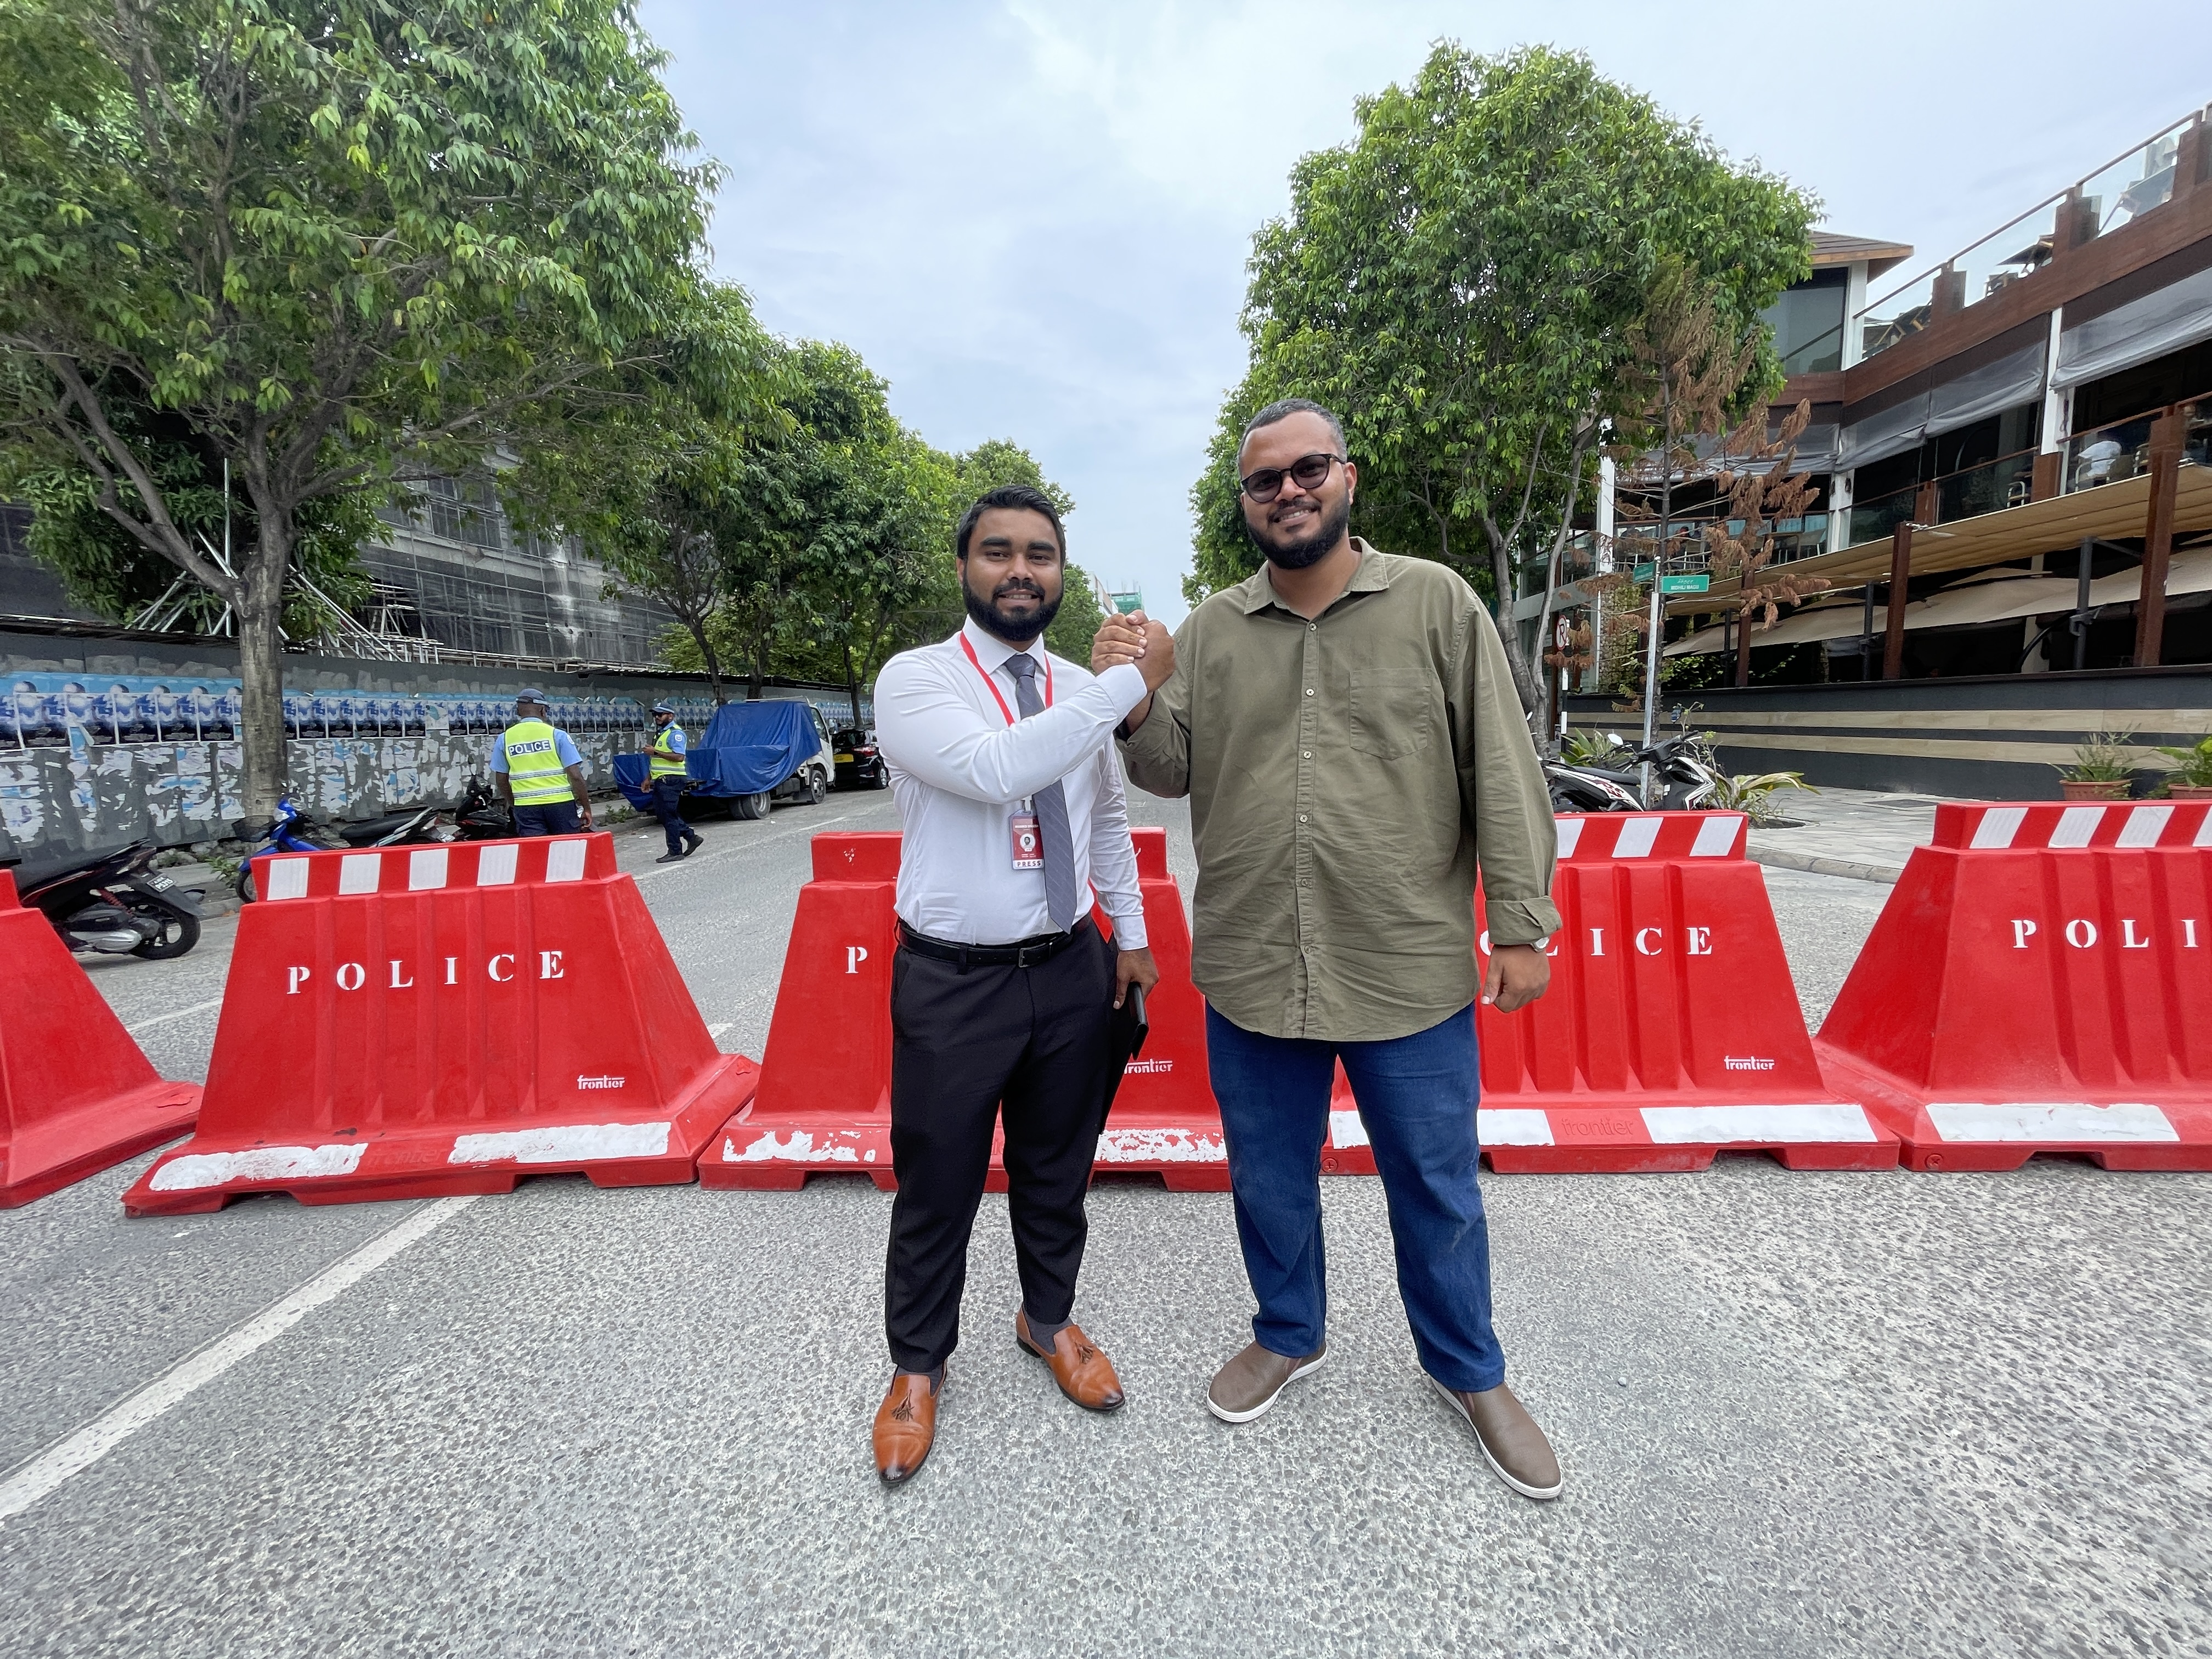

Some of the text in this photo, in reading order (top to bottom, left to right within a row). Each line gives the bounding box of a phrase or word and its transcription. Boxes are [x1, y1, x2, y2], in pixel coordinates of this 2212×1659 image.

[509, 741, 550, 755] POLICE
[2010, 919, 2199, 949] POLI
[286, 951, 565, 995] POLICE
[1724, 1055, 1775, 1070] frontier
[577, 1075, 625, 1090] frontier
[1562, 1117, 1634, 1136] frontier
